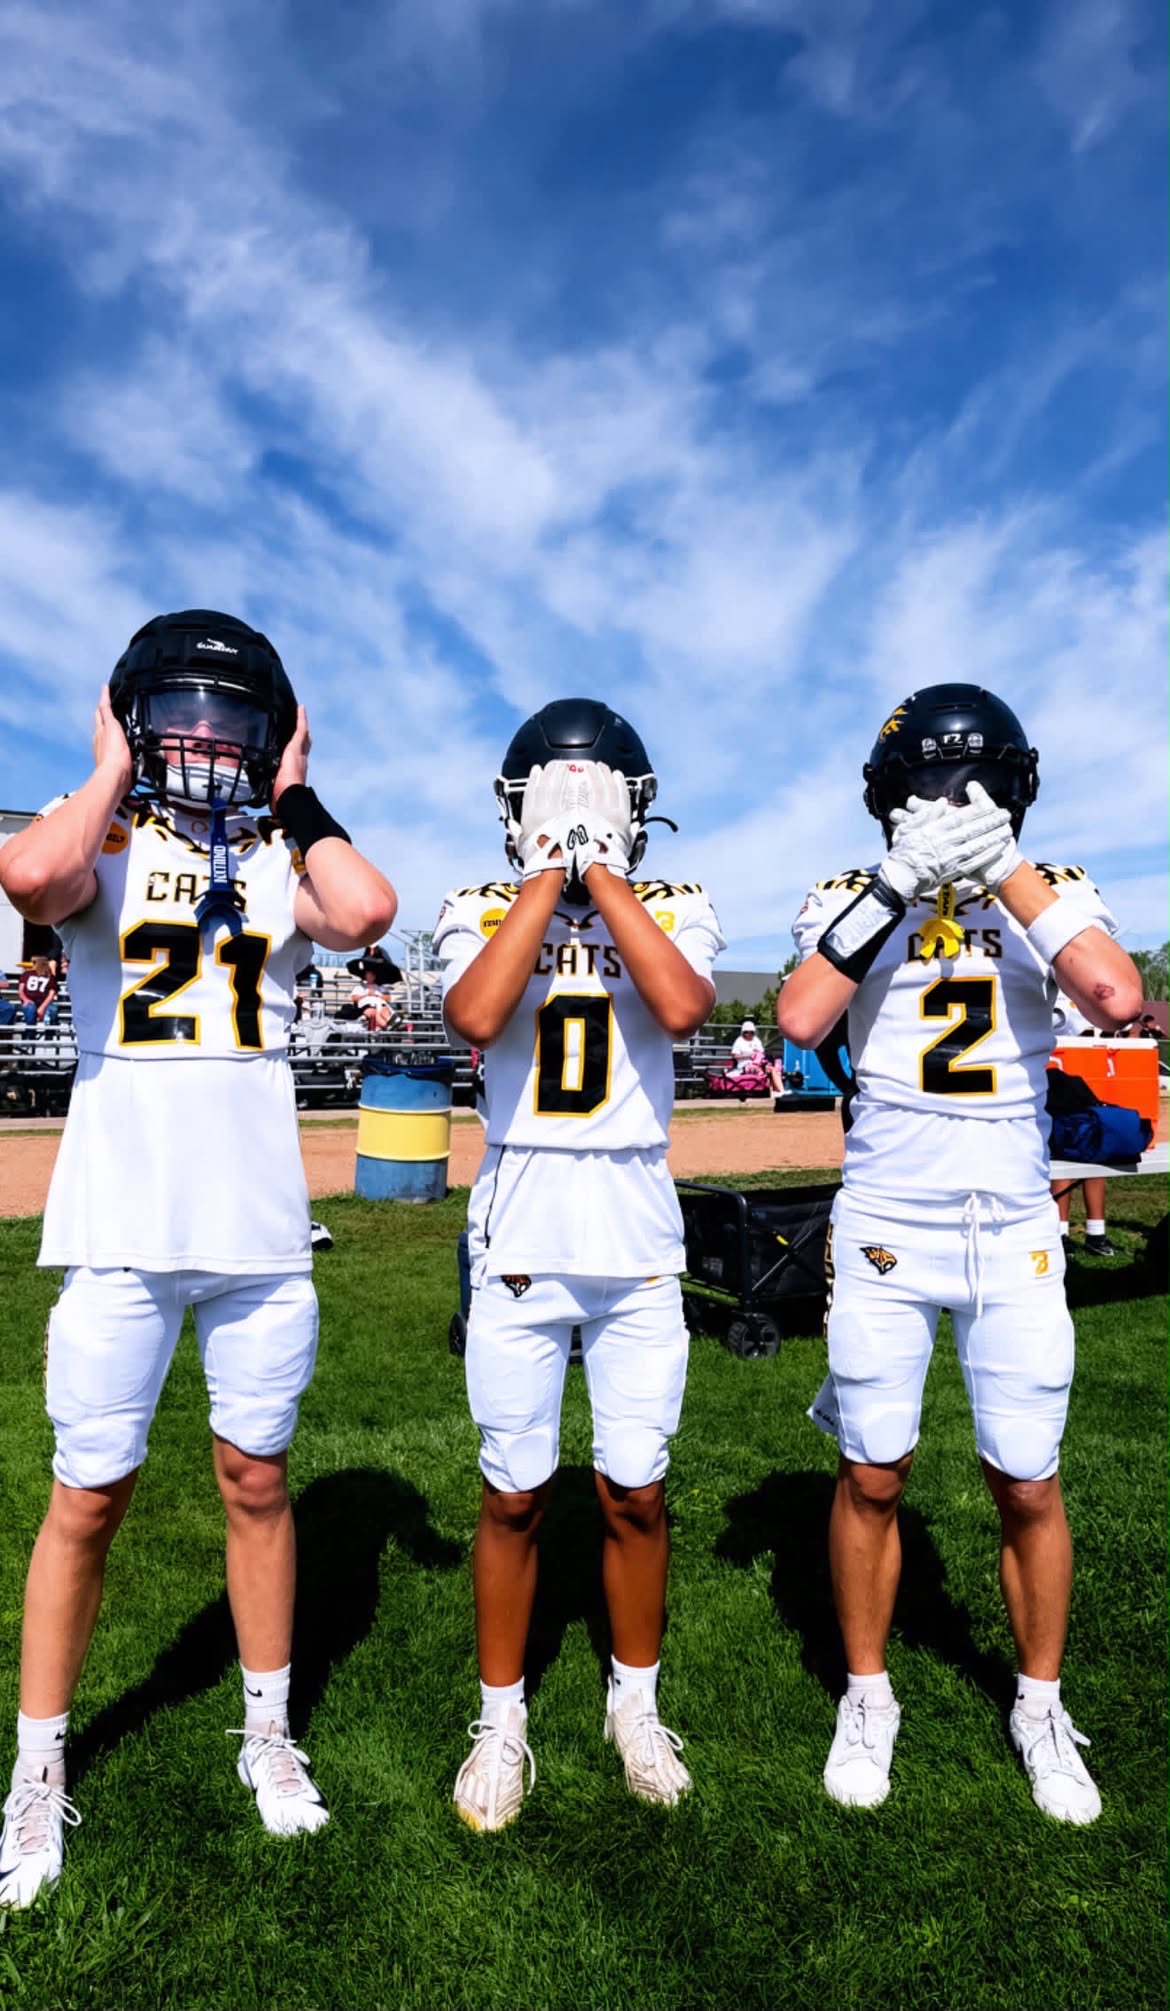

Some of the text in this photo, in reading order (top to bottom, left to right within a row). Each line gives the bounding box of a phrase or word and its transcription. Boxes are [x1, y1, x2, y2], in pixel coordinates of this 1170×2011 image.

[147, 871, 246, 913] CAS
[119, 918, 272, 1051] 21
[534, 943, 621, 978] CATS
[534, 991, 613, 1118] 0
[919, 975, 997, 1095] 2
